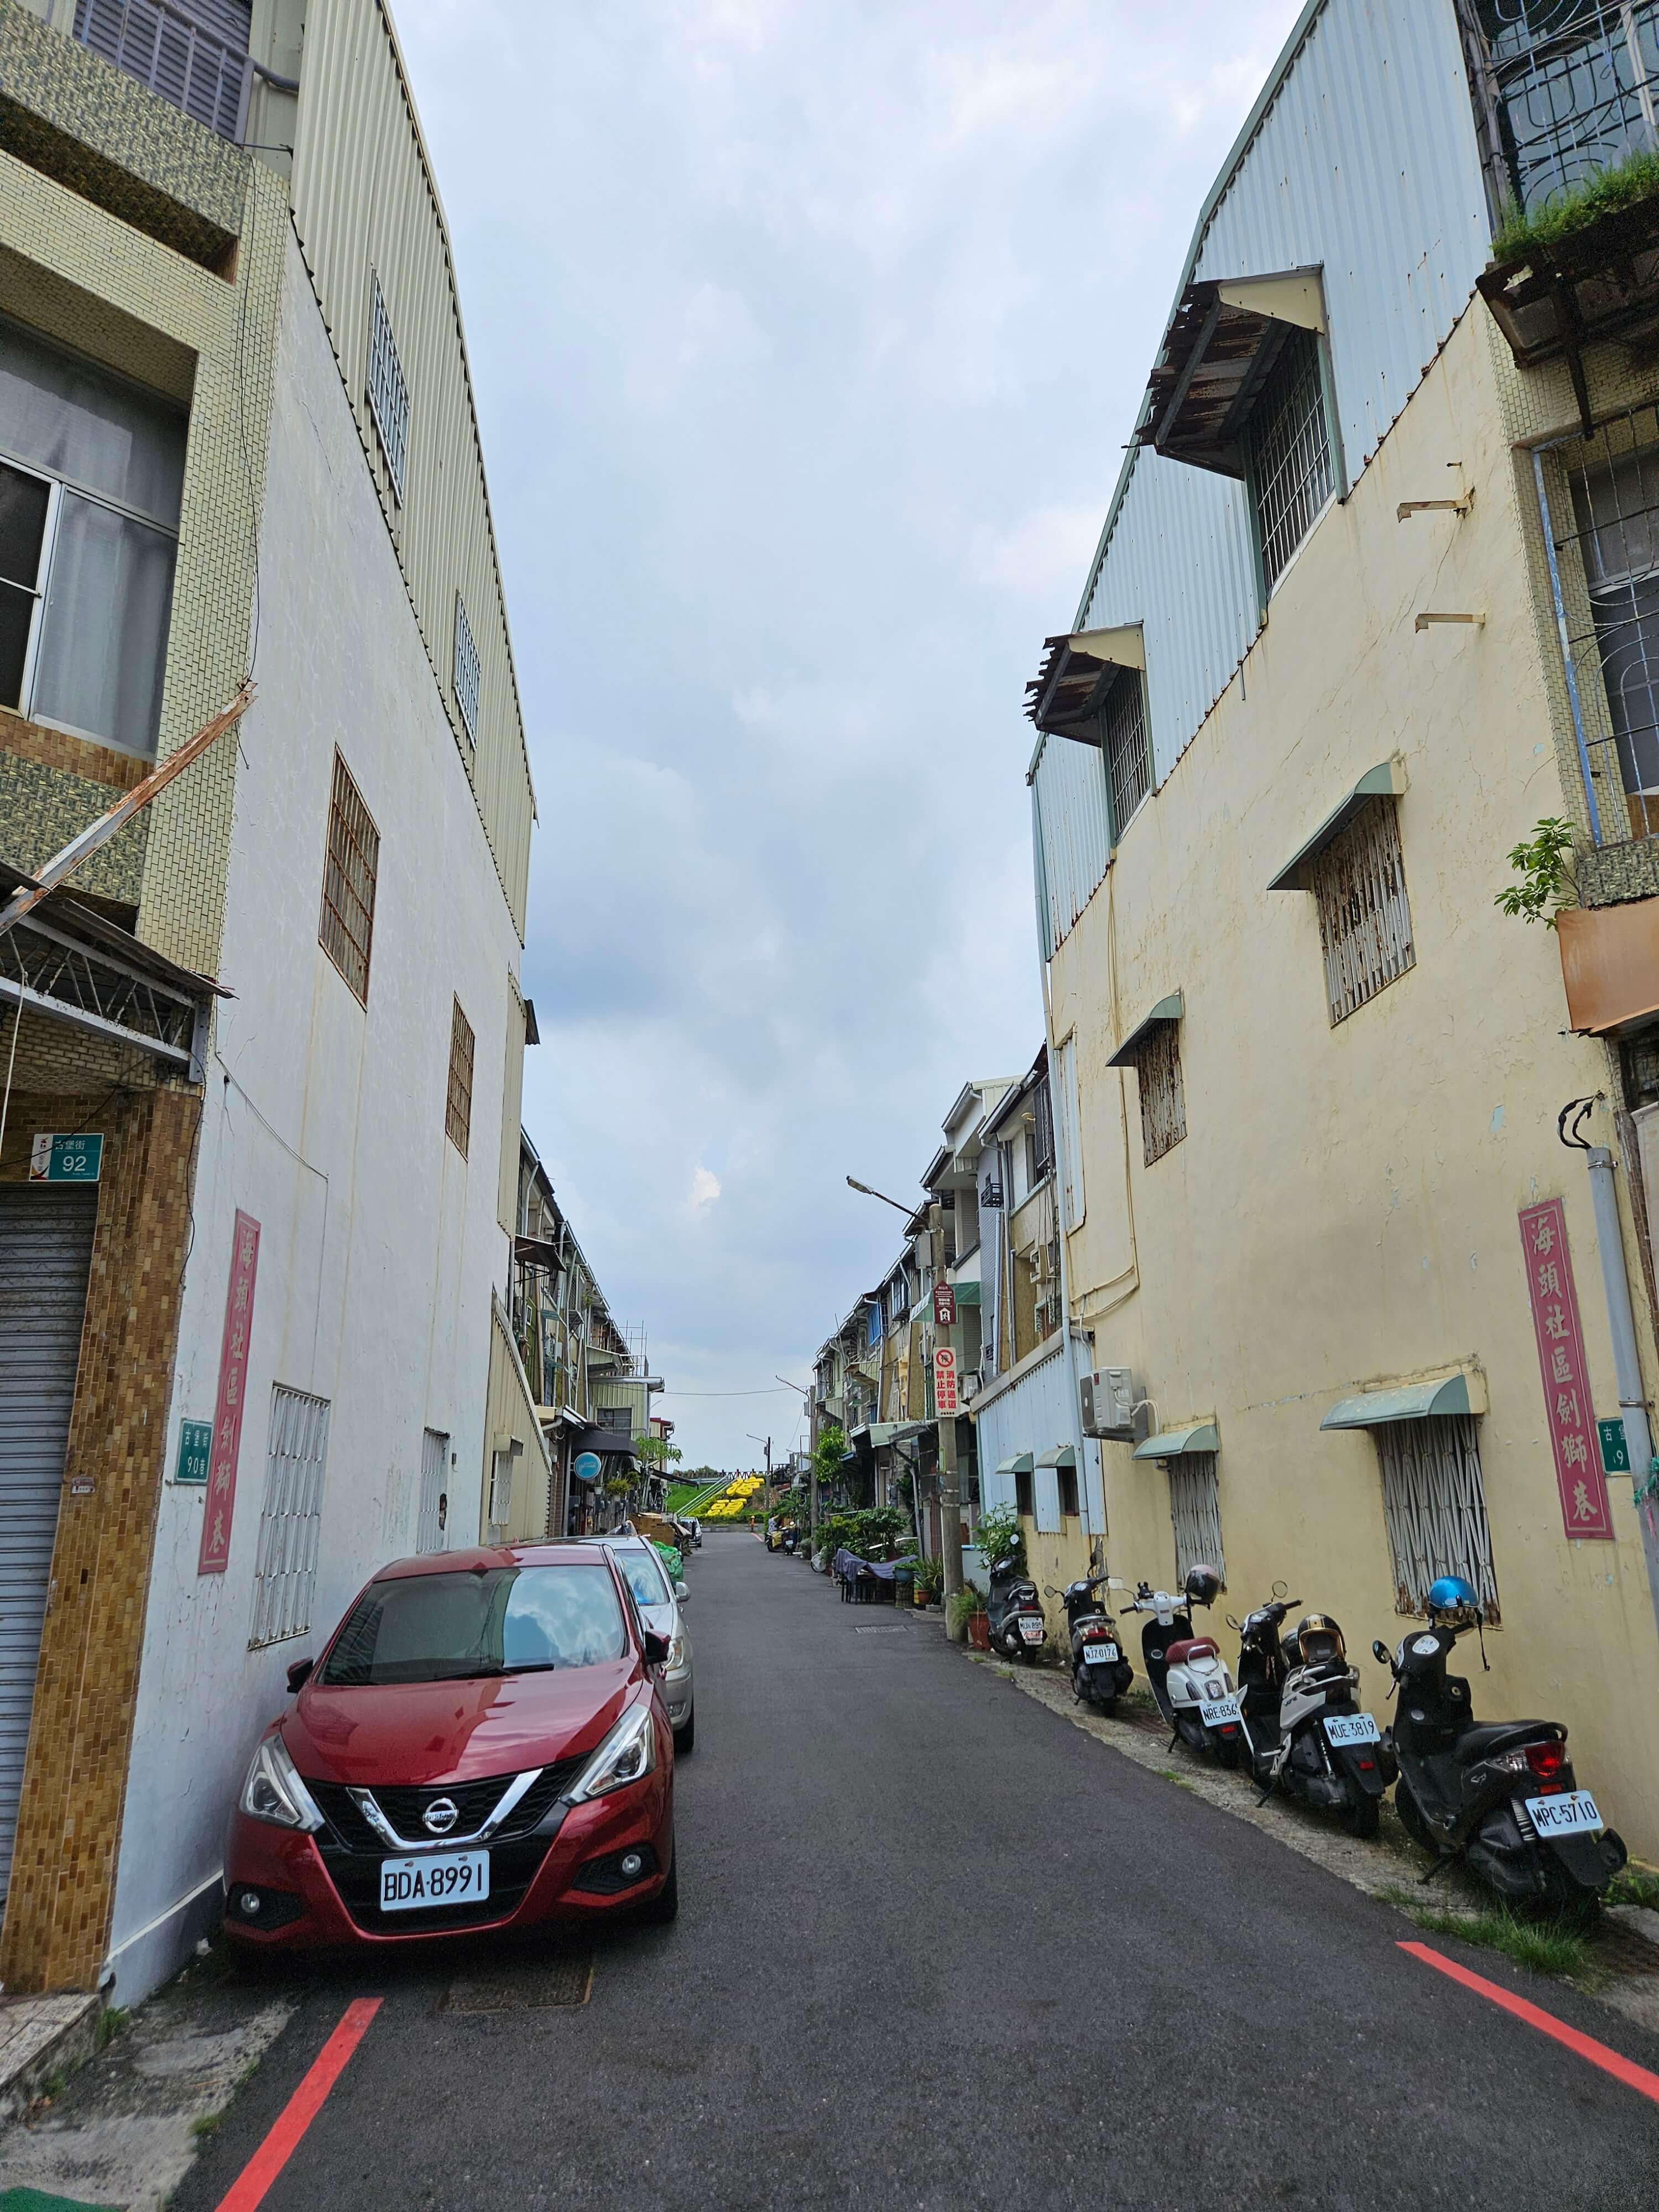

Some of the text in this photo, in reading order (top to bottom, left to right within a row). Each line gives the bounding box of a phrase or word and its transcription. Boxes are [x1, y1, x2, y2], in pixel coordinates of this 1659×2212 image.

[55, 1140, 86, 1150] 古堡街
[62, 1155, 87, 1172] 92
[1531, 1217, 1598, 1521] 海頭社區劍獅巷
[185, 1428, 209, 1448] 古堡街
